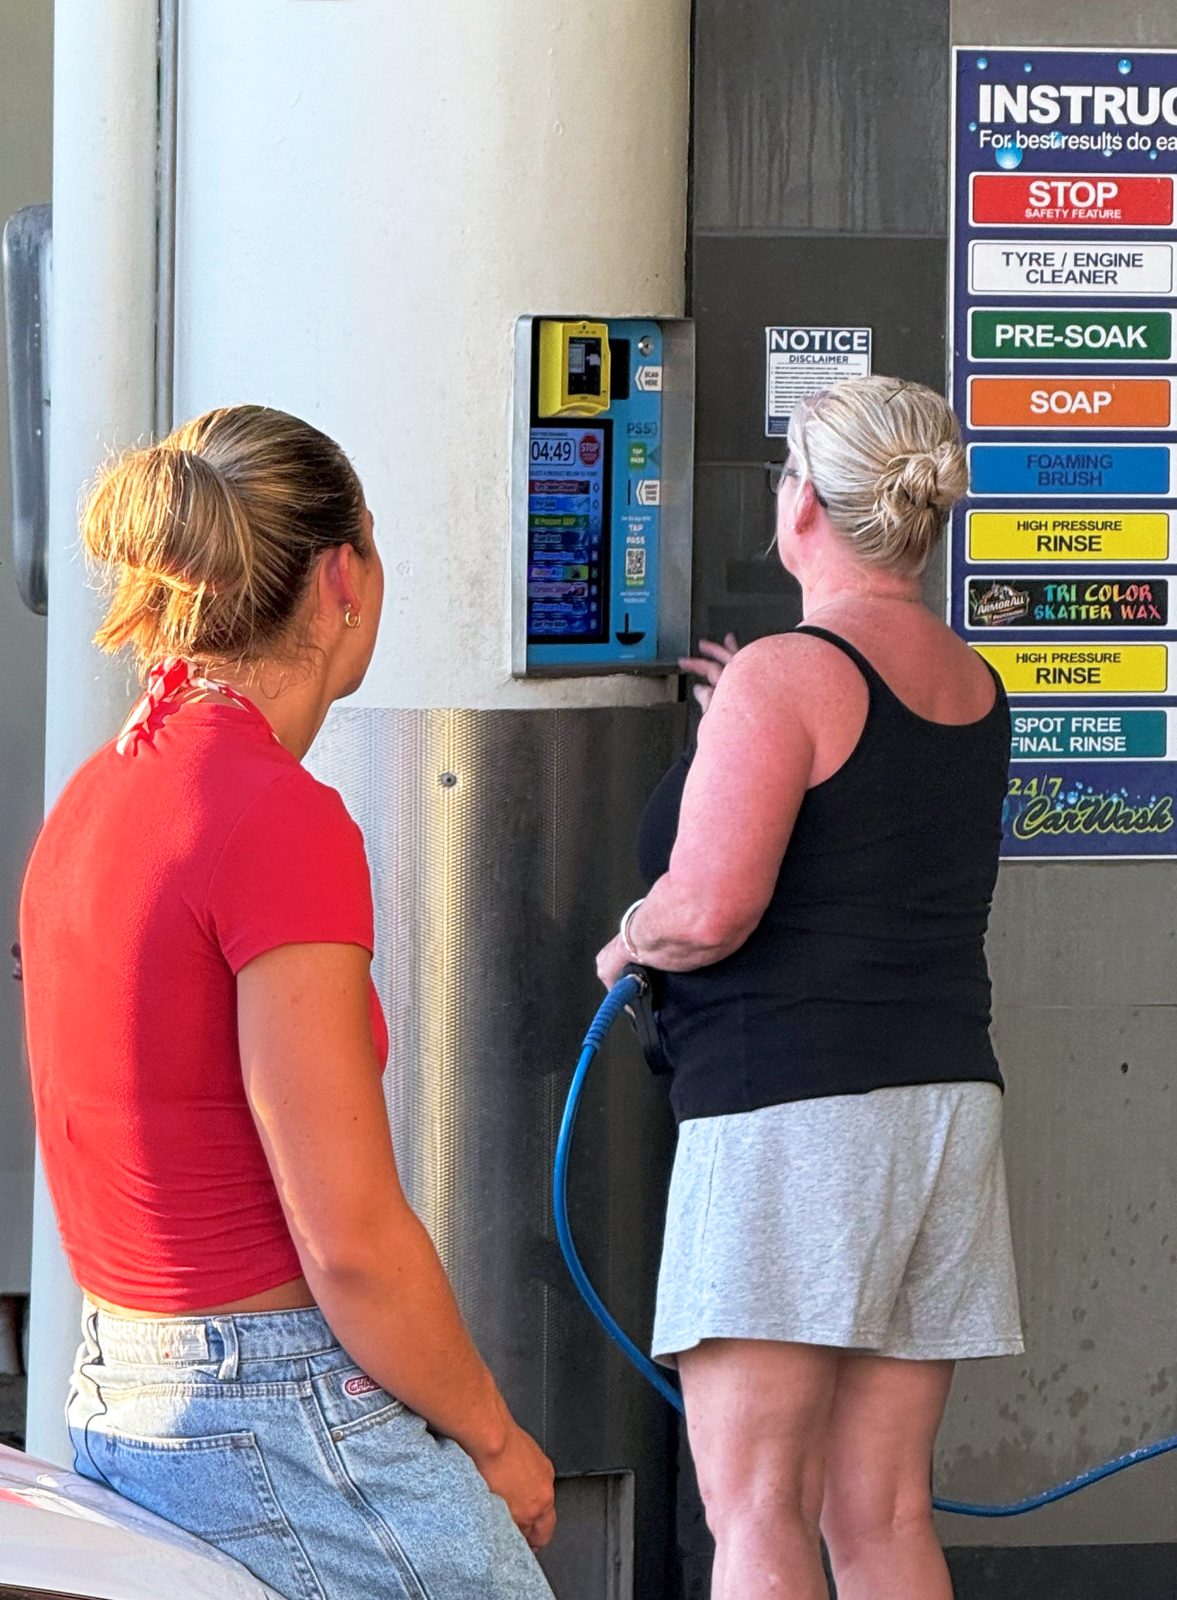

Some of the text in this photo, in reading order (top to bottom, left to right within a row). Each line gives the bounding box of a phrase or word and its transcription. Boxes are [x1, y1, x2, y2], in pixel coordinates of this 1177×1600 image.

[979, 131, 1012, 149] For
[1016, 131, 1055, 149] best
[1061, 132, 1122, 150] results
[1127, 132, 1151, 150] do
[1029, 181, 1118, 208] STOP
[1025, 209, 1121, 219] SAFETY FEATURE
[1002, 252, 1143, 268] TYRE / ENGINE
[1026, 269, 1118, 284] CLEANER
[771, 330, 868, 351] NOTICE
[995, 324, 1147, 348] PRE-SOAK
[789, 355, 849, 363] DISCLAIMER
[1030, 390, 1112, 414] SOAP
[531, 441, 572, 462] 04:49
[581, 444, 598, 452] STOP
[1026, 454, 1113, 469] FOAMING
[1038, 471, 1103, 486] BRUSH
[628, 524, 643, 532] TAP
[1017, 520, 1122, 531] HIGH PRESSURE
[1037, 535, 1102, 552] RINSE
[1044, 584, 1152, 602] TRI COLOR
[1033, 604, 1112, 620] SKATTER
[1120, 604, 1161, 620] WAX
[1016, 653, 1121, 664] HIGH PRESSURE
[1036, 668, 1101, 684] RINSE
[1014, 717, 1122, 732] SPOT FREE
[1011, 737, 1126, 752] FINAL RINSE
[1008, 775, 1062, 798] 24/7
